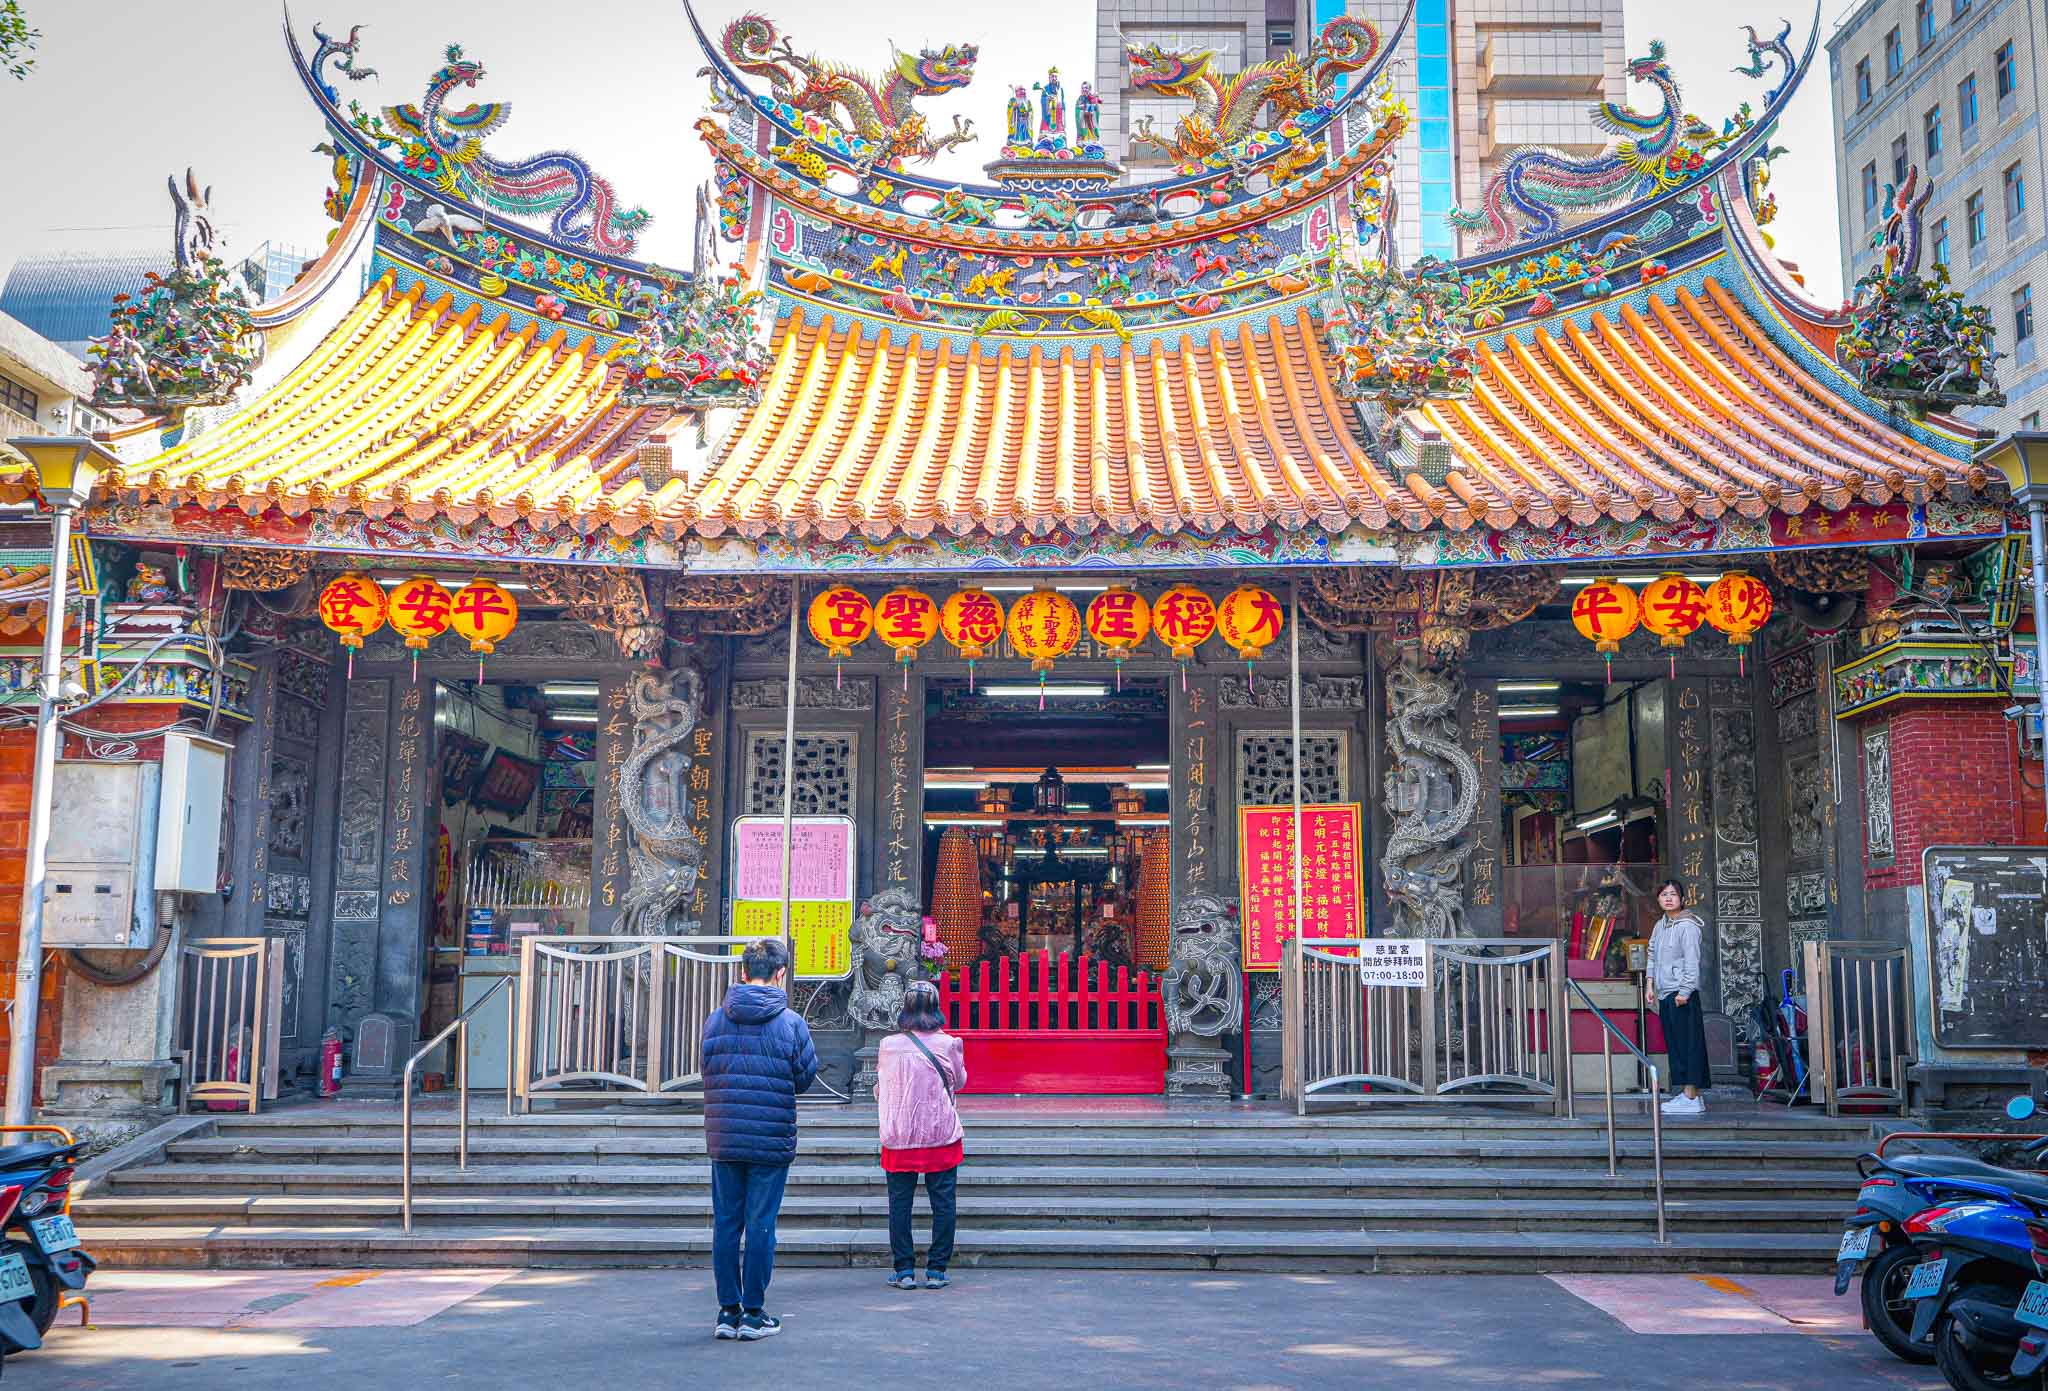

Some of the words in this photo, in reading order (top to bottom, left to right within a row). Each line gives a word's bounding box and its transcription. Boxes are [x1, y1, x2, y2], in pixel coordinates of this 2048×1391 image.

[1017, 596, 1038, 649] 吉祥如意
[1040, 596, 1061, 649] 天上聖母
[1250, 883, 1261, 914] 大稻埕
[1302, 855, 1314, 920] 合家平安燈
[1362, 956, 1423, 967] 開放參拜時間
[1375, 944, 1410, 955] 慈聖宮
[1363, 970, 1424, 980] 07:00-18:00
